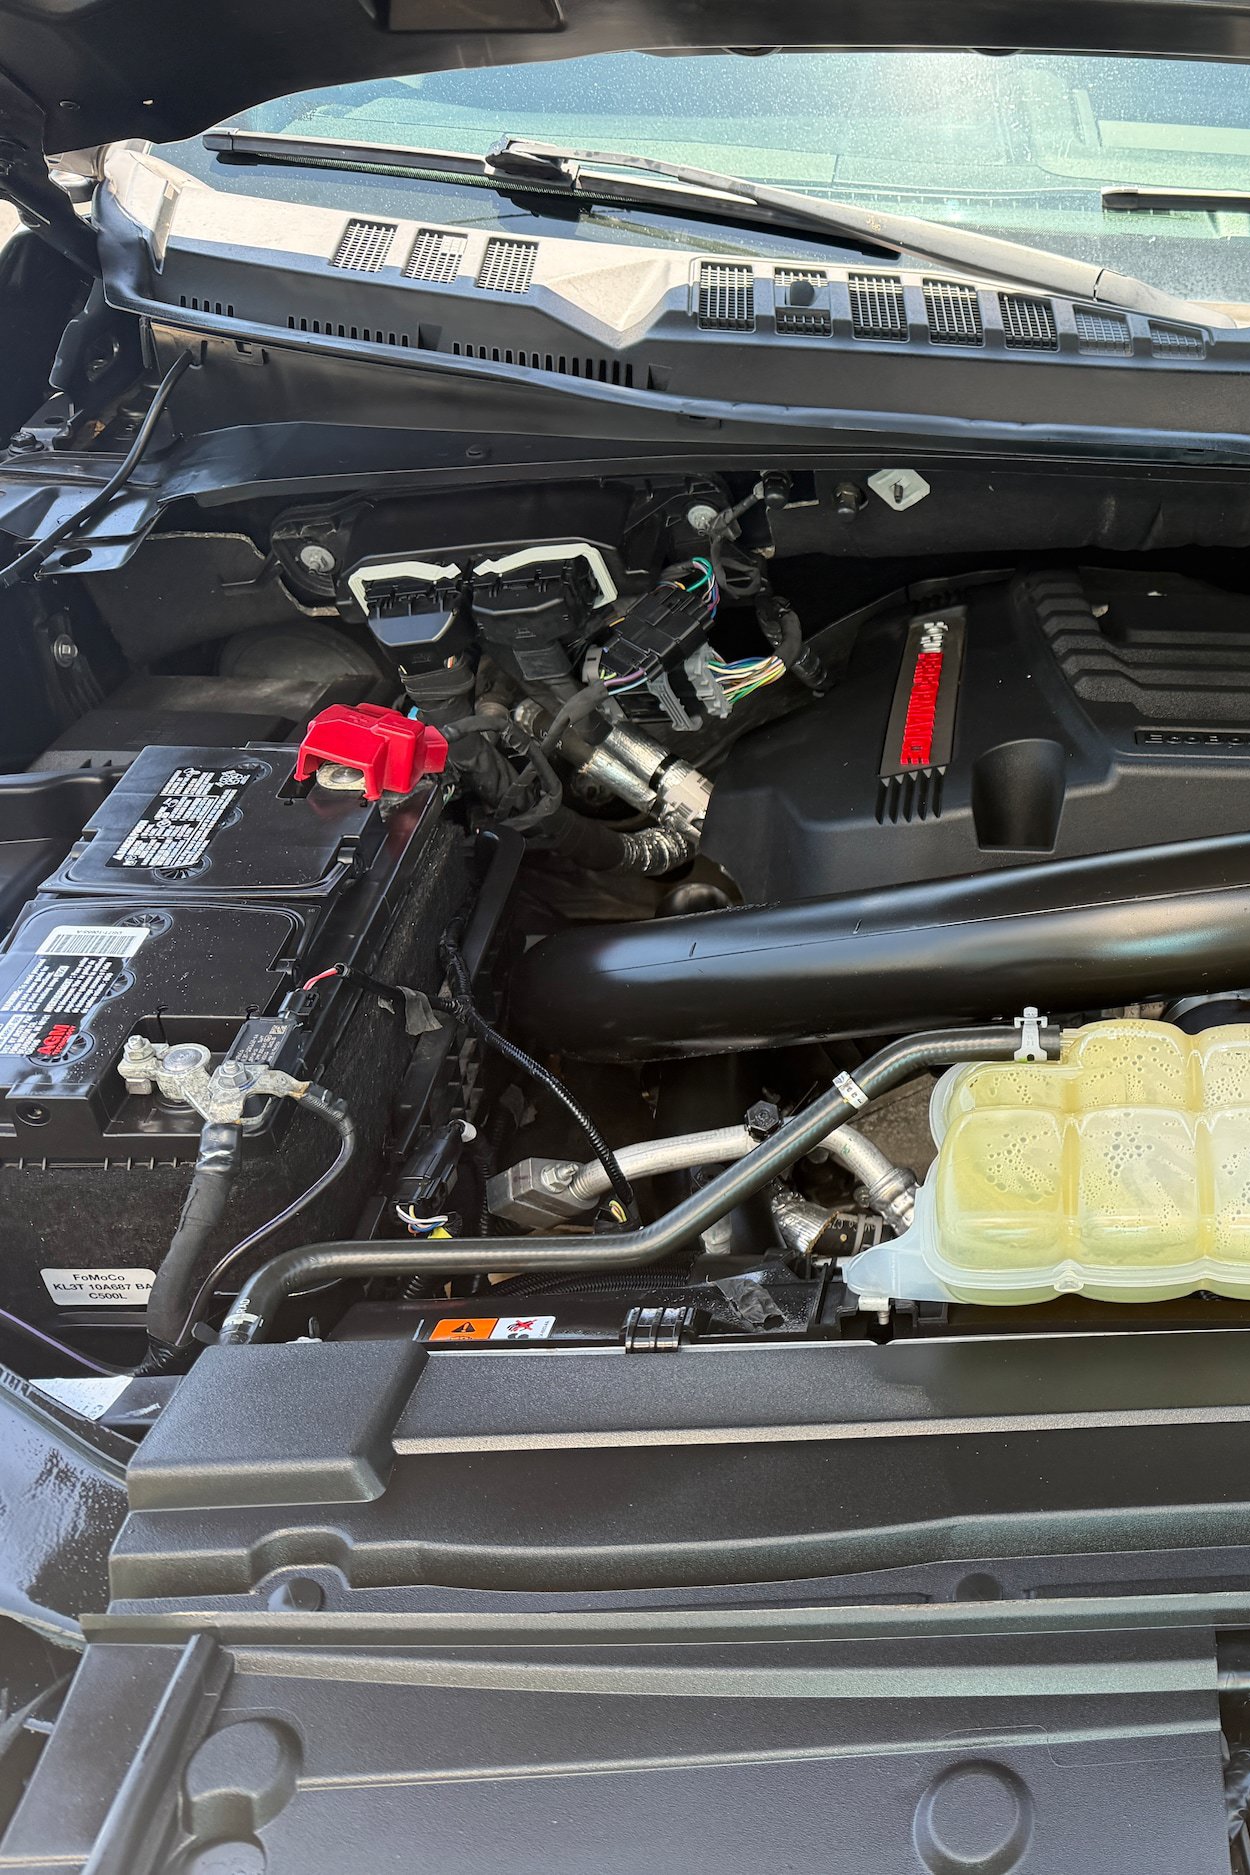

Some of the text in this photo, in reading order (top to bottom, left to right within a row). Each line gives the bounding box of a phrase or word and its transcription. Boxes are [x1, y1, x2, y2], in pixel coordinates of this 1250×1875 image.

[901, 652, 944, 765] PERFORMANCE
[37, 1024, 71, 1055] AGM
[53, 1283, 84, 1291] KL3T
[89, 1283, 131, 1291] 10A687
[89, 1292, 127, 1300] C500L
